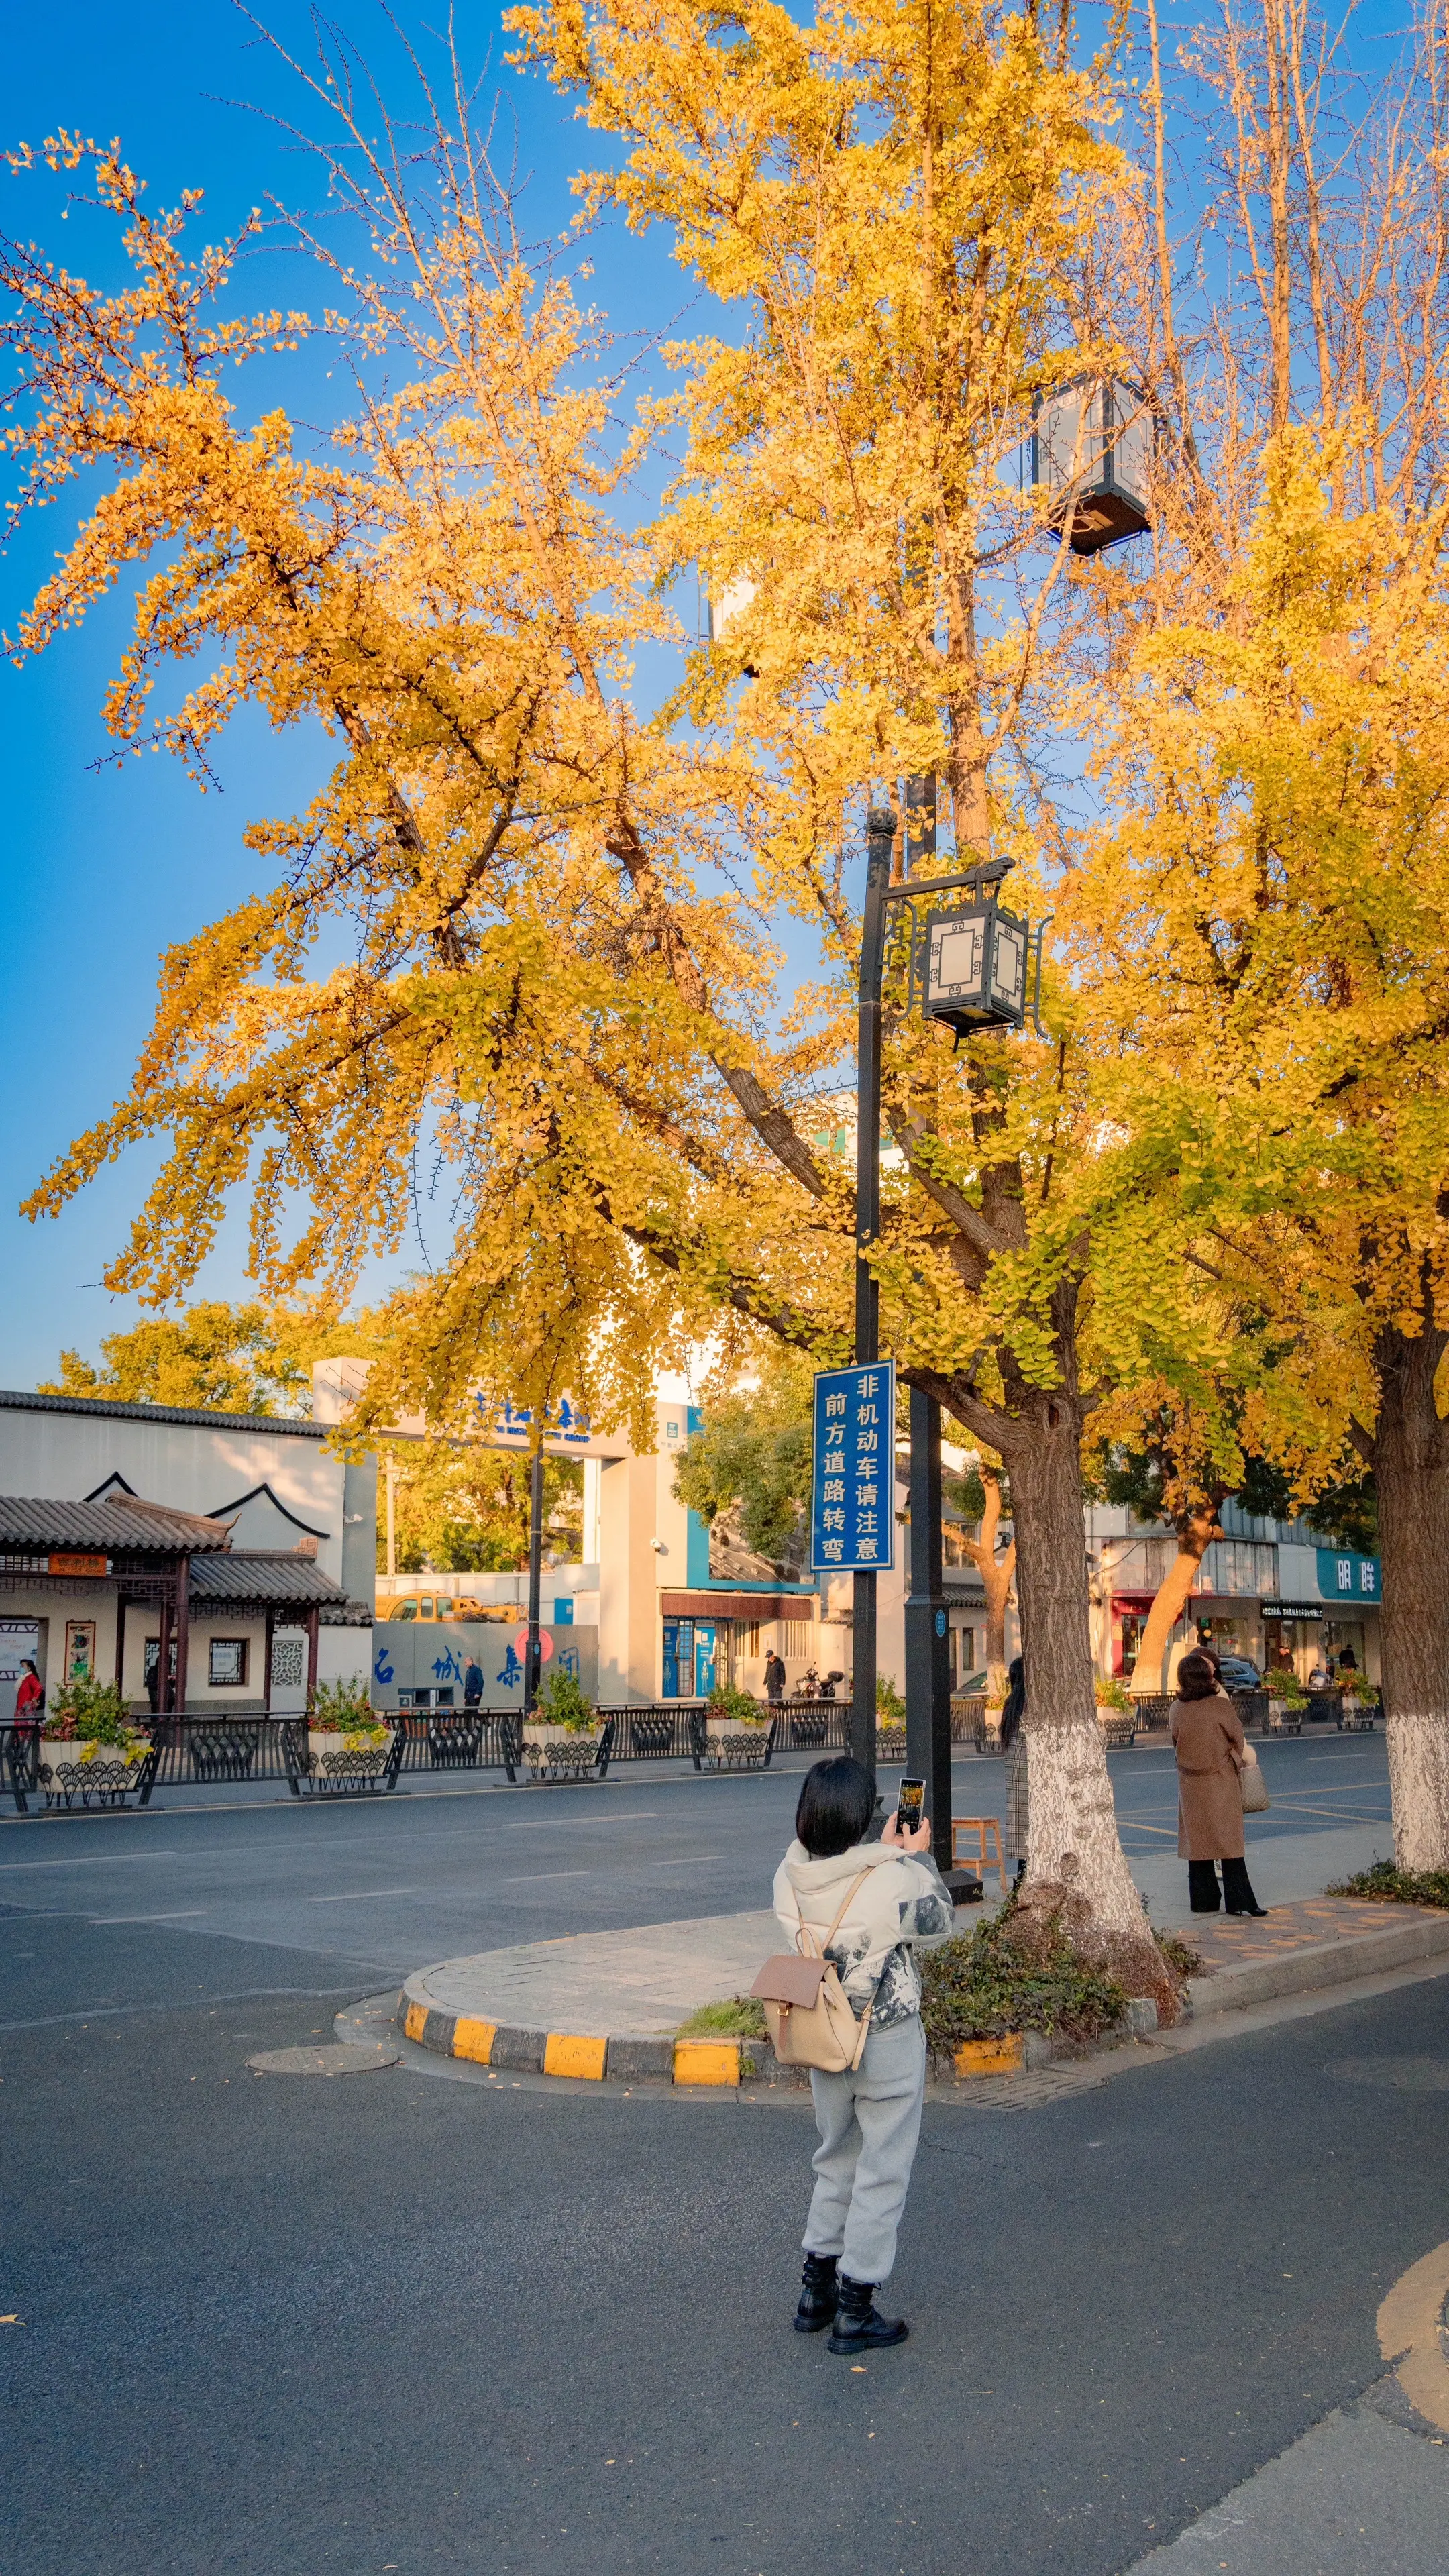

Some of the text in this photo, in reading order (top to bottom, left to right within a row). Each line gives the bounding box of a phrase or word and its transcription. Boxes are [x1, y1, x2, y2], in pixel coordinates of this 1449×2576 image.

[822, 1391, 847, 1562] 前方道路转弯
[855, 1374, 879, 1560] 非机动车请注意
